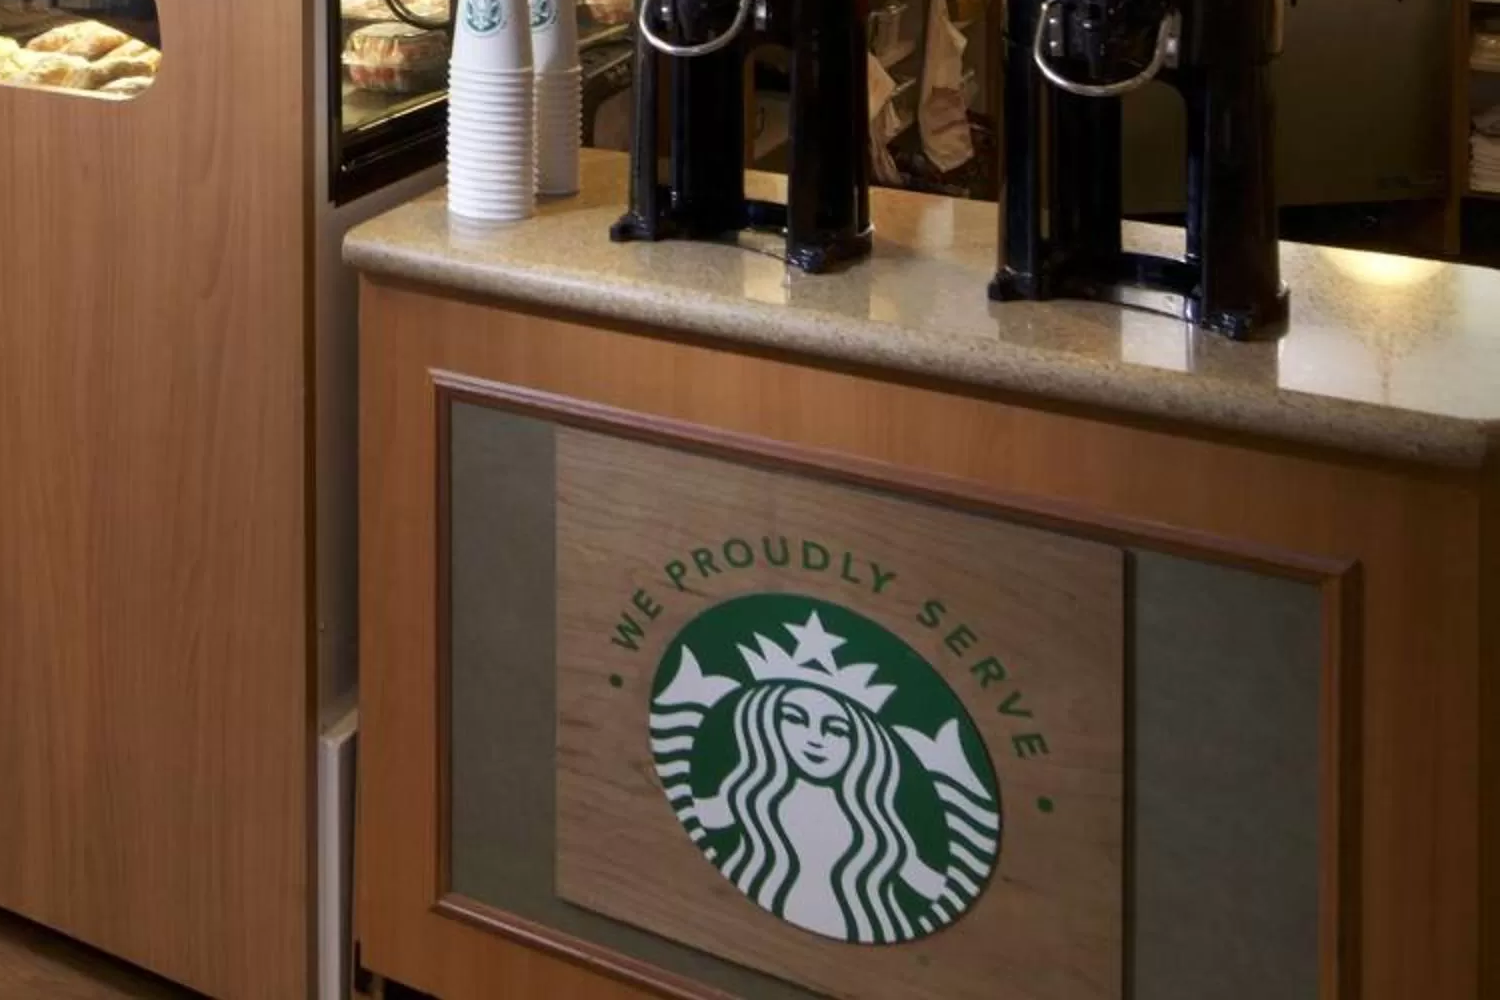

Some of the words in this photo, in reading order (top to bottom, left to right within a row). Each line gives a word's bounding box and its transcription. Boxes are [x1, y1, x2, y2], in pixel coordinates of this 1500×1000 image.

[611, 588, 664, 652] WE
[664, 535, 897, 594] PROUDLY
[915, 599, 1050, 760] SERVE
